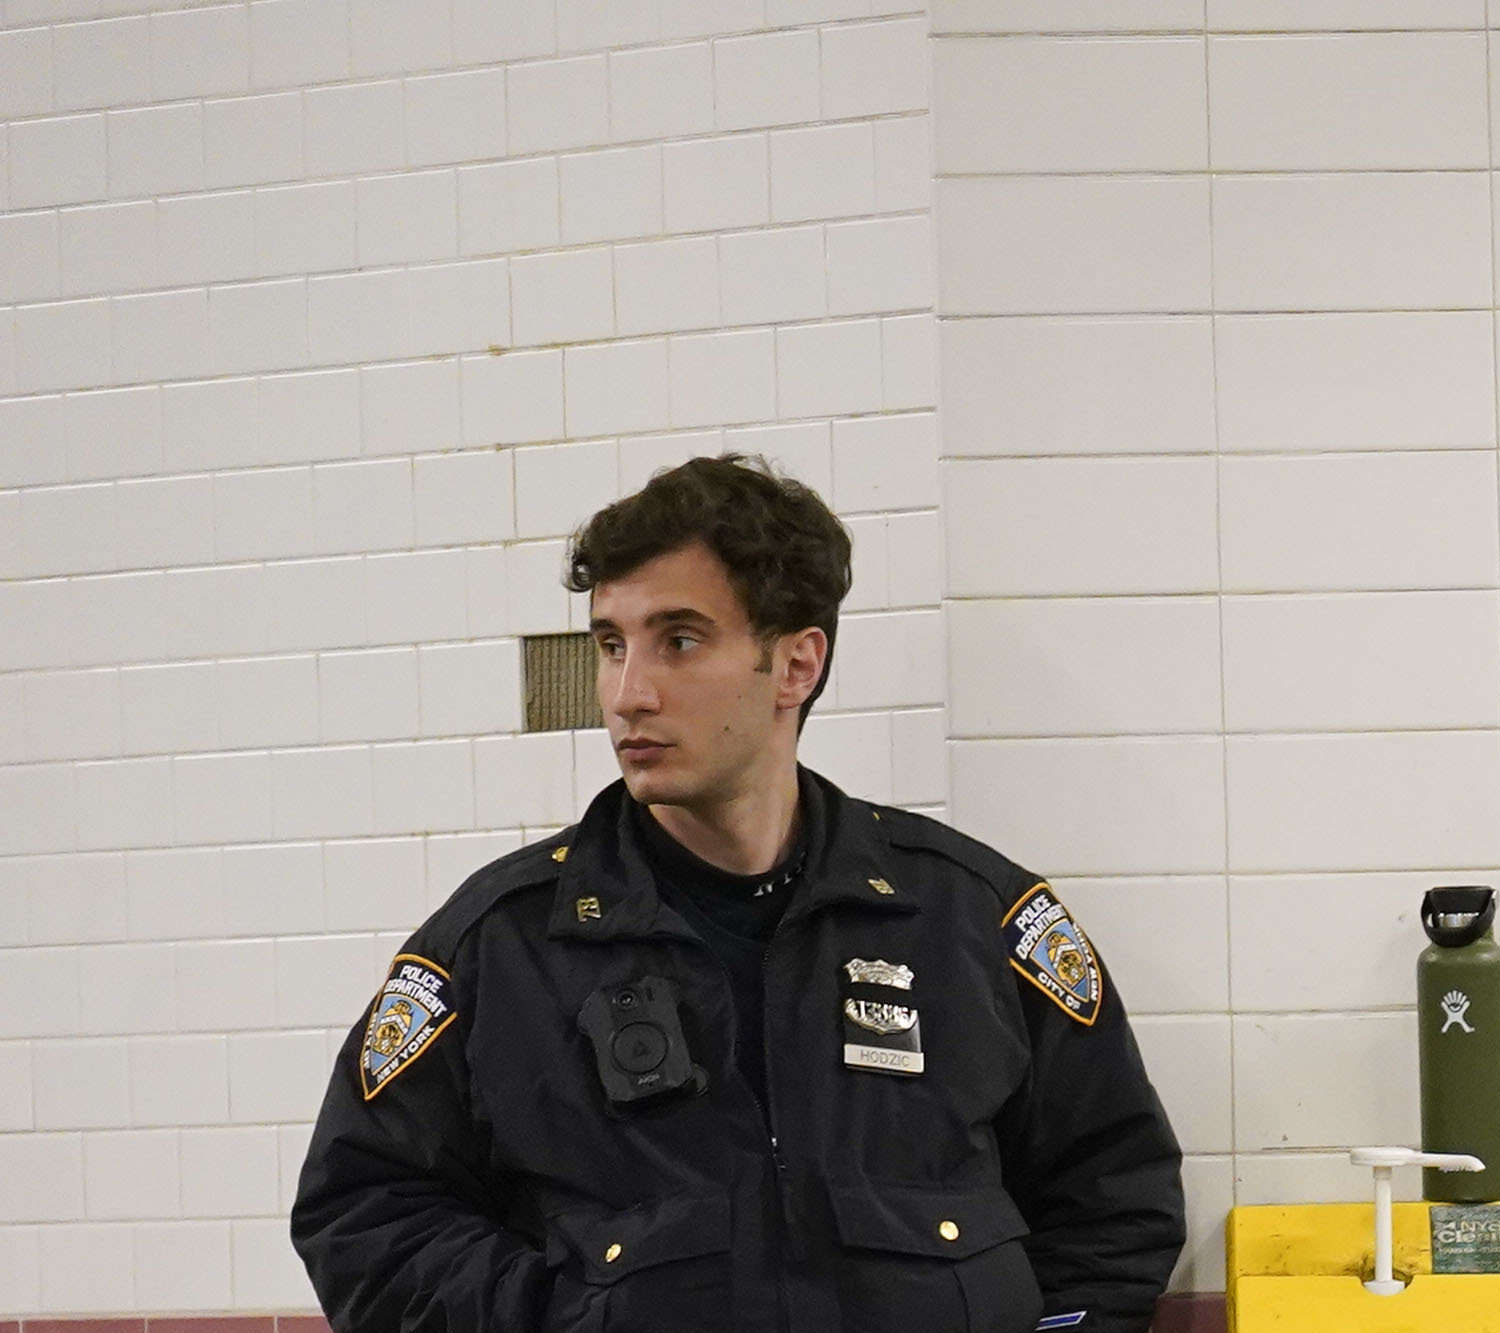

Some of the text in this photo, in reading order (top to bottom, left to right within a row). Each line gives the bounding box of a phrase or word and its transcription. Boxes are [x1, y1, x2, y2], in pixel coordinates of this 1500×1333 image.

[1015, 894, 1052, 932] POLICE
[400, 965, 443, 993] POLICE
[1038, 972, 1064, 997] CITY
[384, 978, 447, 1018] DEPARTMENT
[377, 1057, 400, 1084] NEW
[401, 1025, 436, 1059] YORK
[861, 1050, 910, 1067] HODZIC
